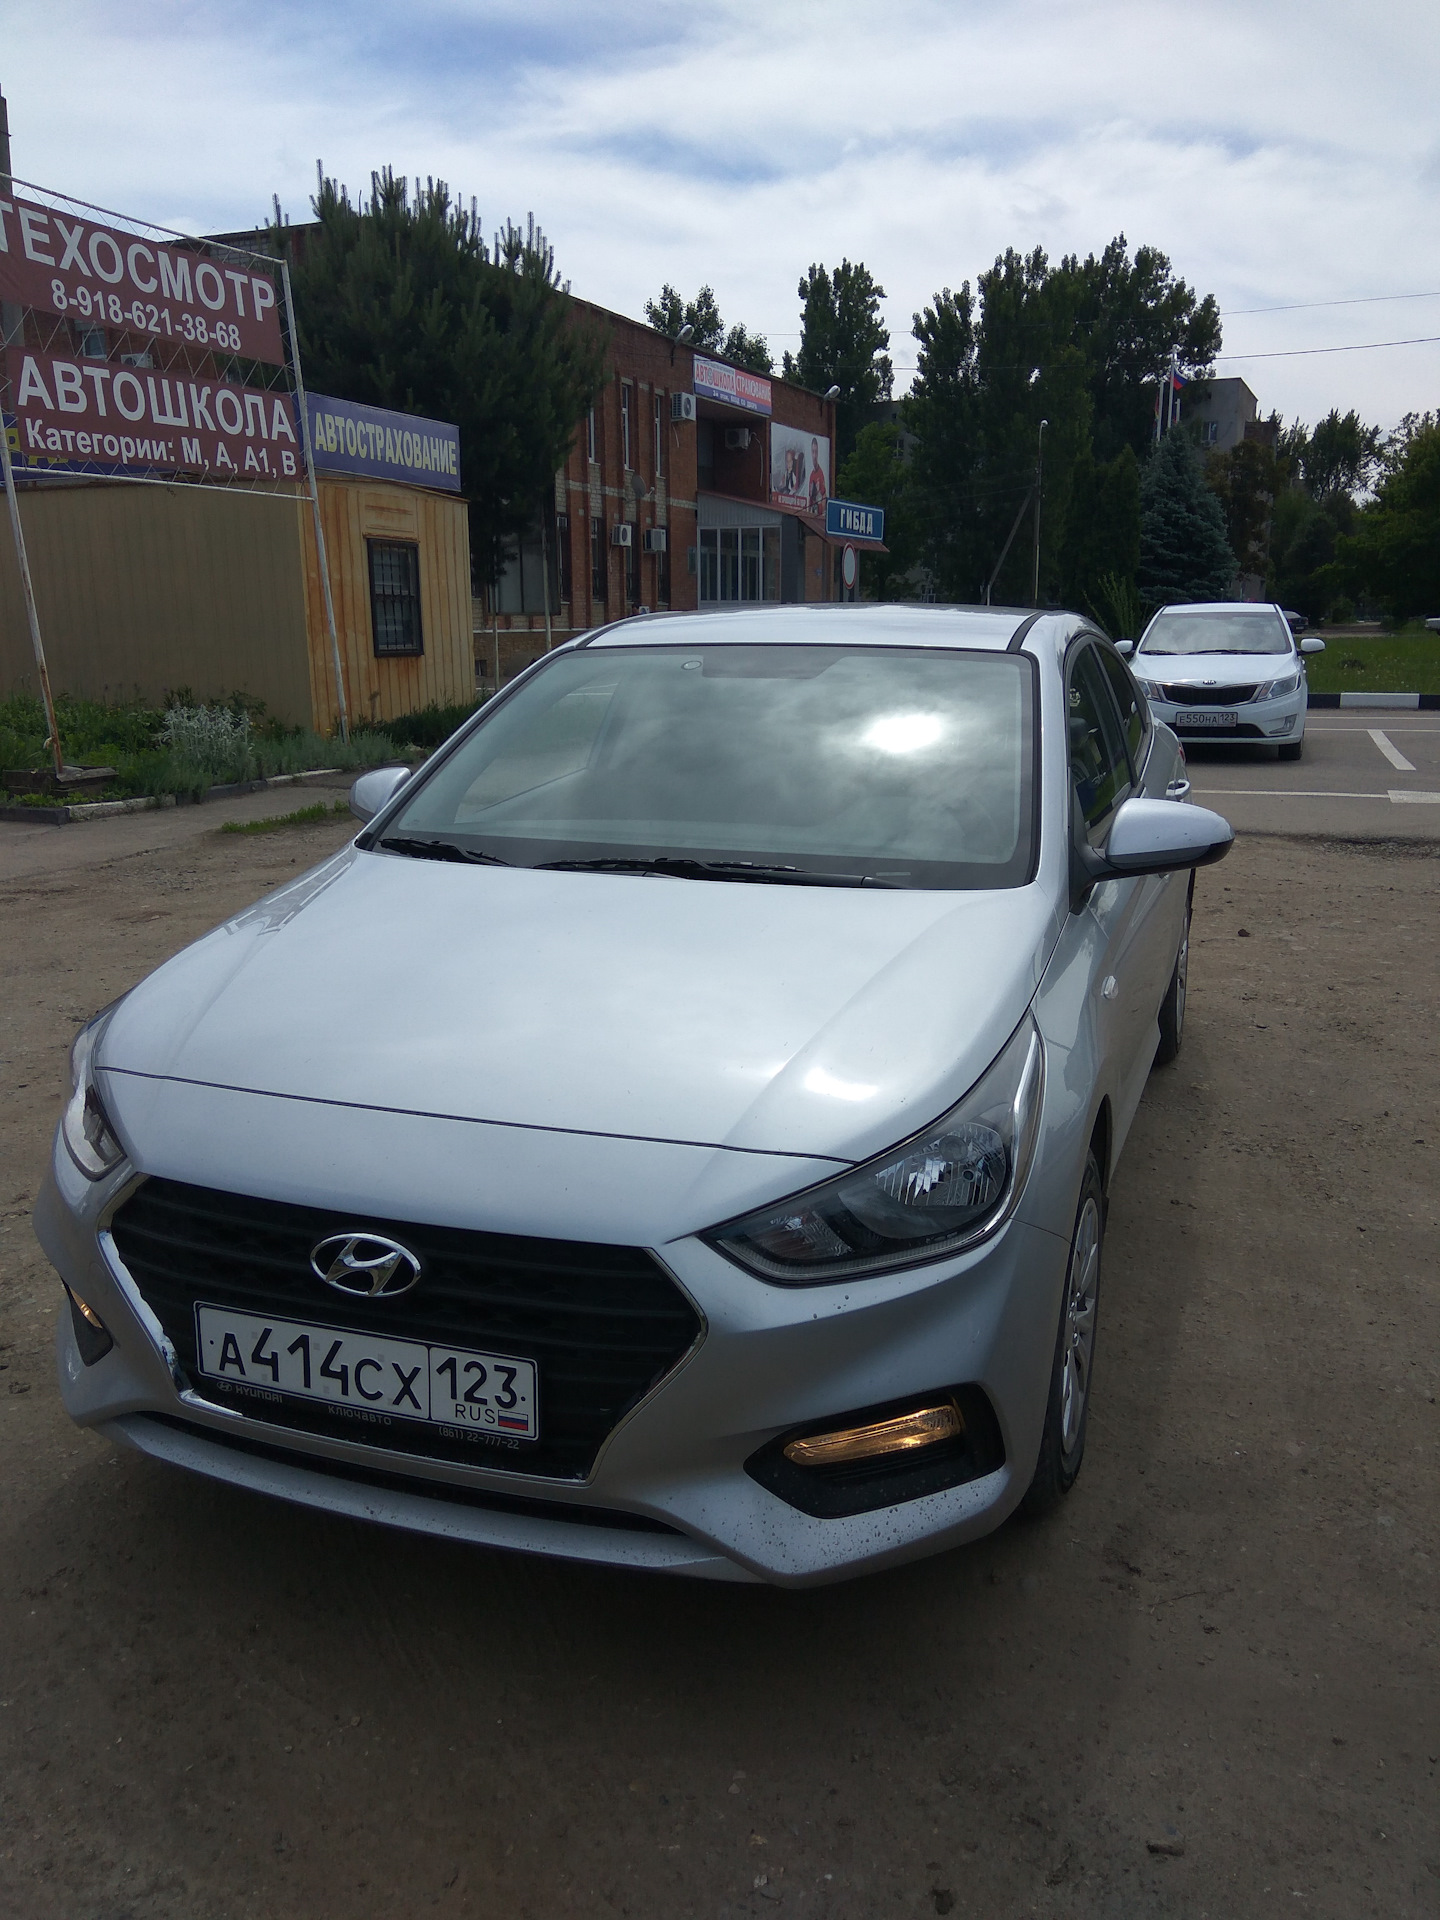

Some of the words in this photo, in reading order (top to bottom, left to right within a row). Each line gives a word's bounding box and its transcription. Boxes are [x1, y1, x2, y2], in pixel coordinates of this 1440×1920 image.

[51, 279, 242, 351] 8-918-621-38-68
[18, 355, 296, 443] АВТОШКОЛА
[25, 418, 175, 464] Категории:
[181, 437, 209, 468] М,
[216, 442, 238, 474] А,
[281, 451, 297, 476] В
[315, 412, 457, 476] АВТОСТРАХОВАНИЕ
[840, 508, 873, 534] ГИБДД
[436, 1356, 518, 1409] 123
[438, 1426, 464, 1440] (861)
[467, 1431, 520, 1450] 22-777-22
[454, 1403, 496, 1425] RUS
